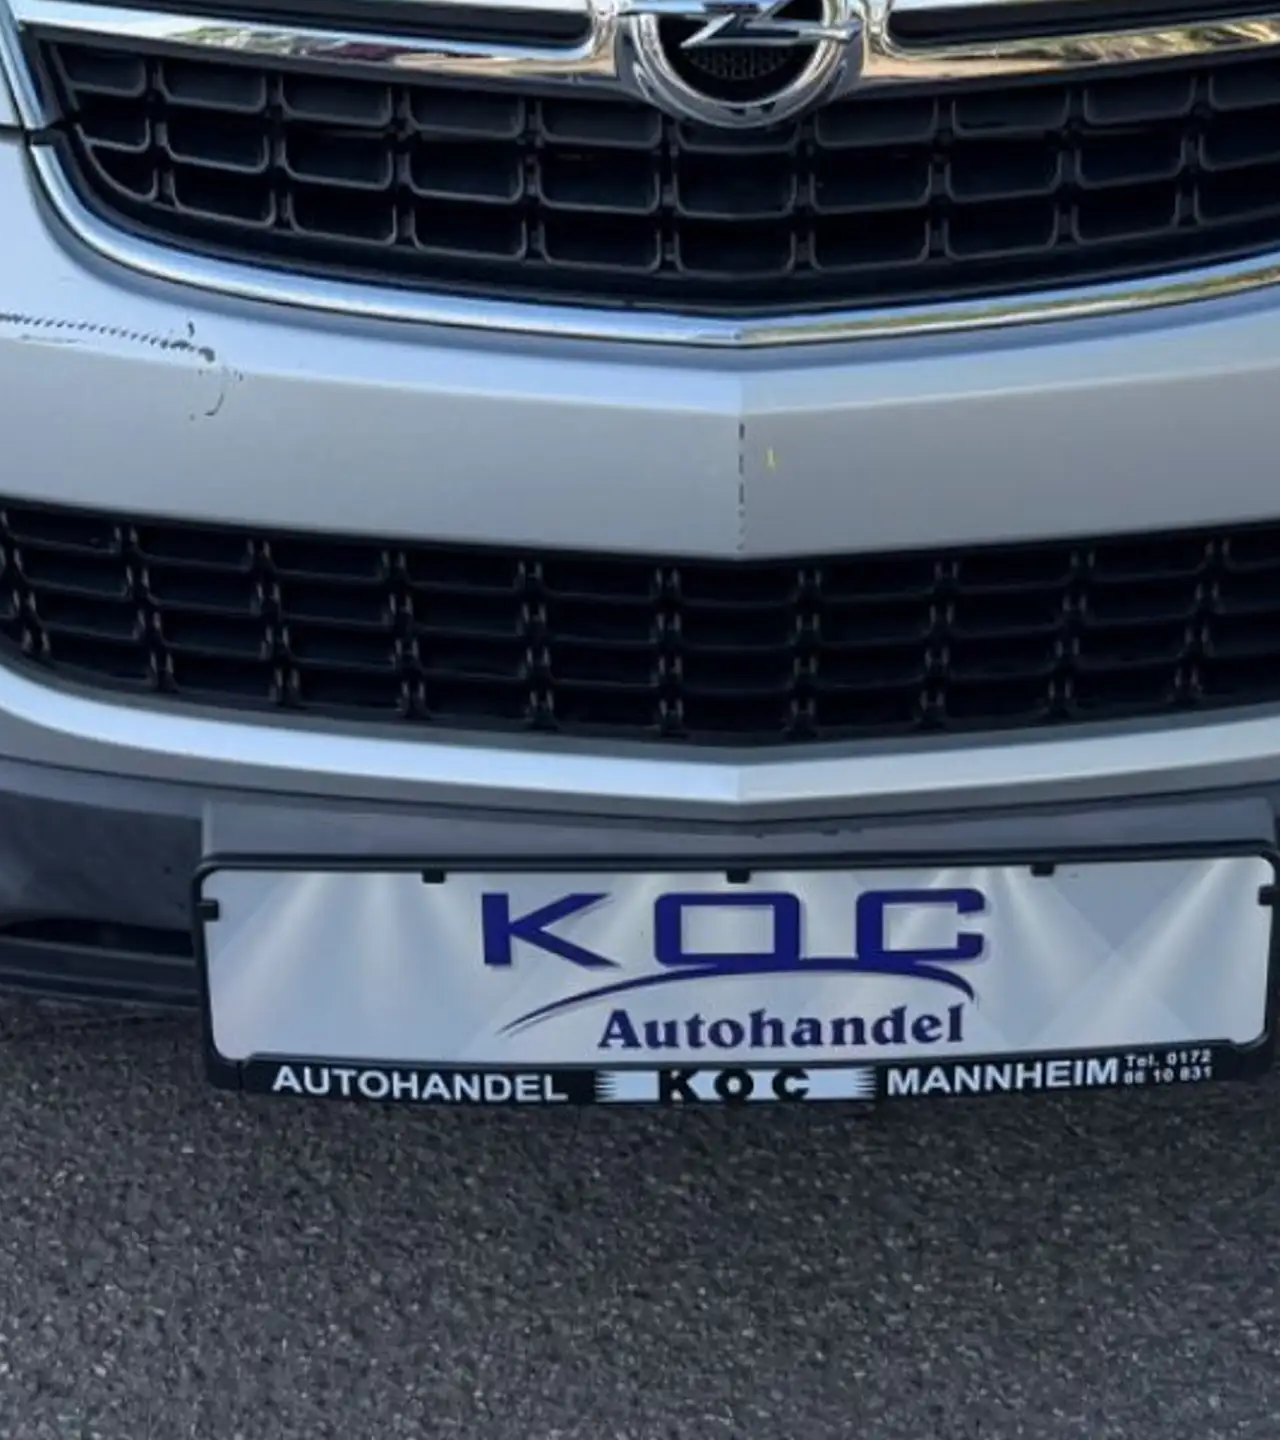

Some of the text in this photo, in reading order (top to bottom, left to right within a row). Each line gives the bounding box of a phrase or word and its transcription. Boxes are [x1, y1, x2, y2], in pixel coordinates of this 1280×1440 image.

[481, 888, 985, 966] KOC
[598, 1002, 963, 1050] Autohandel
[273, 1057, 1119, 1103] AUTOHANDEL KOC MANNHEIM
